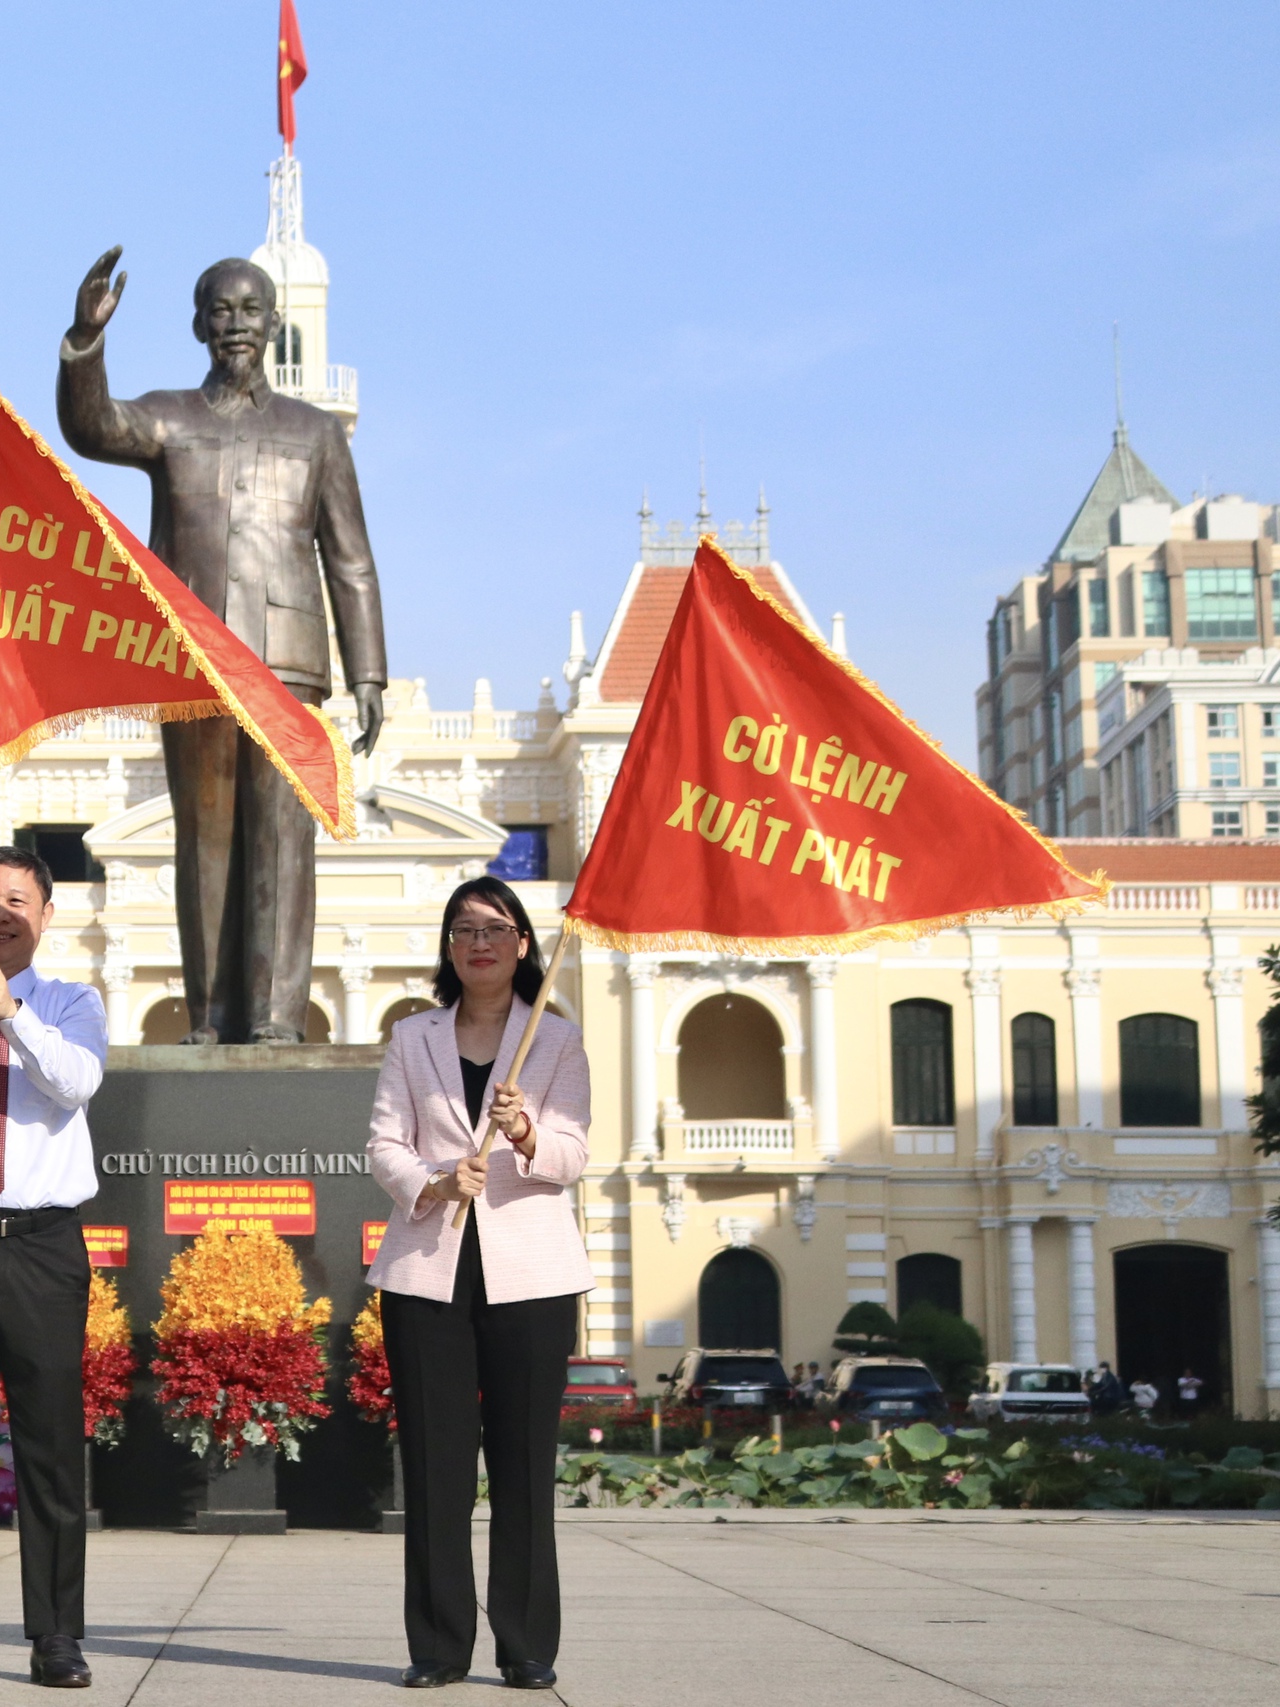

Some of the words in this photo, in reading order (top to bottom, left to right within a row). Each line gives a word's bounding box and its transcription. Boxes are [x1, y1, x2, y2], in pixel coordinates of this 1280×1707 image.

[722, 712, 788, 775] CỜ
[789, 735, 908, 815] LỆNH
[665, 780, 791, 866] XUẤT
[790, 827, 903, 903] PHÁT
[101, 1148, 153, 1175] CHỦ
[159, 1153, 217, 1178] TỊCH
[223, 1146, 259, 1175] HỒ
[263, 1147, 308, 1175] CHÍ
